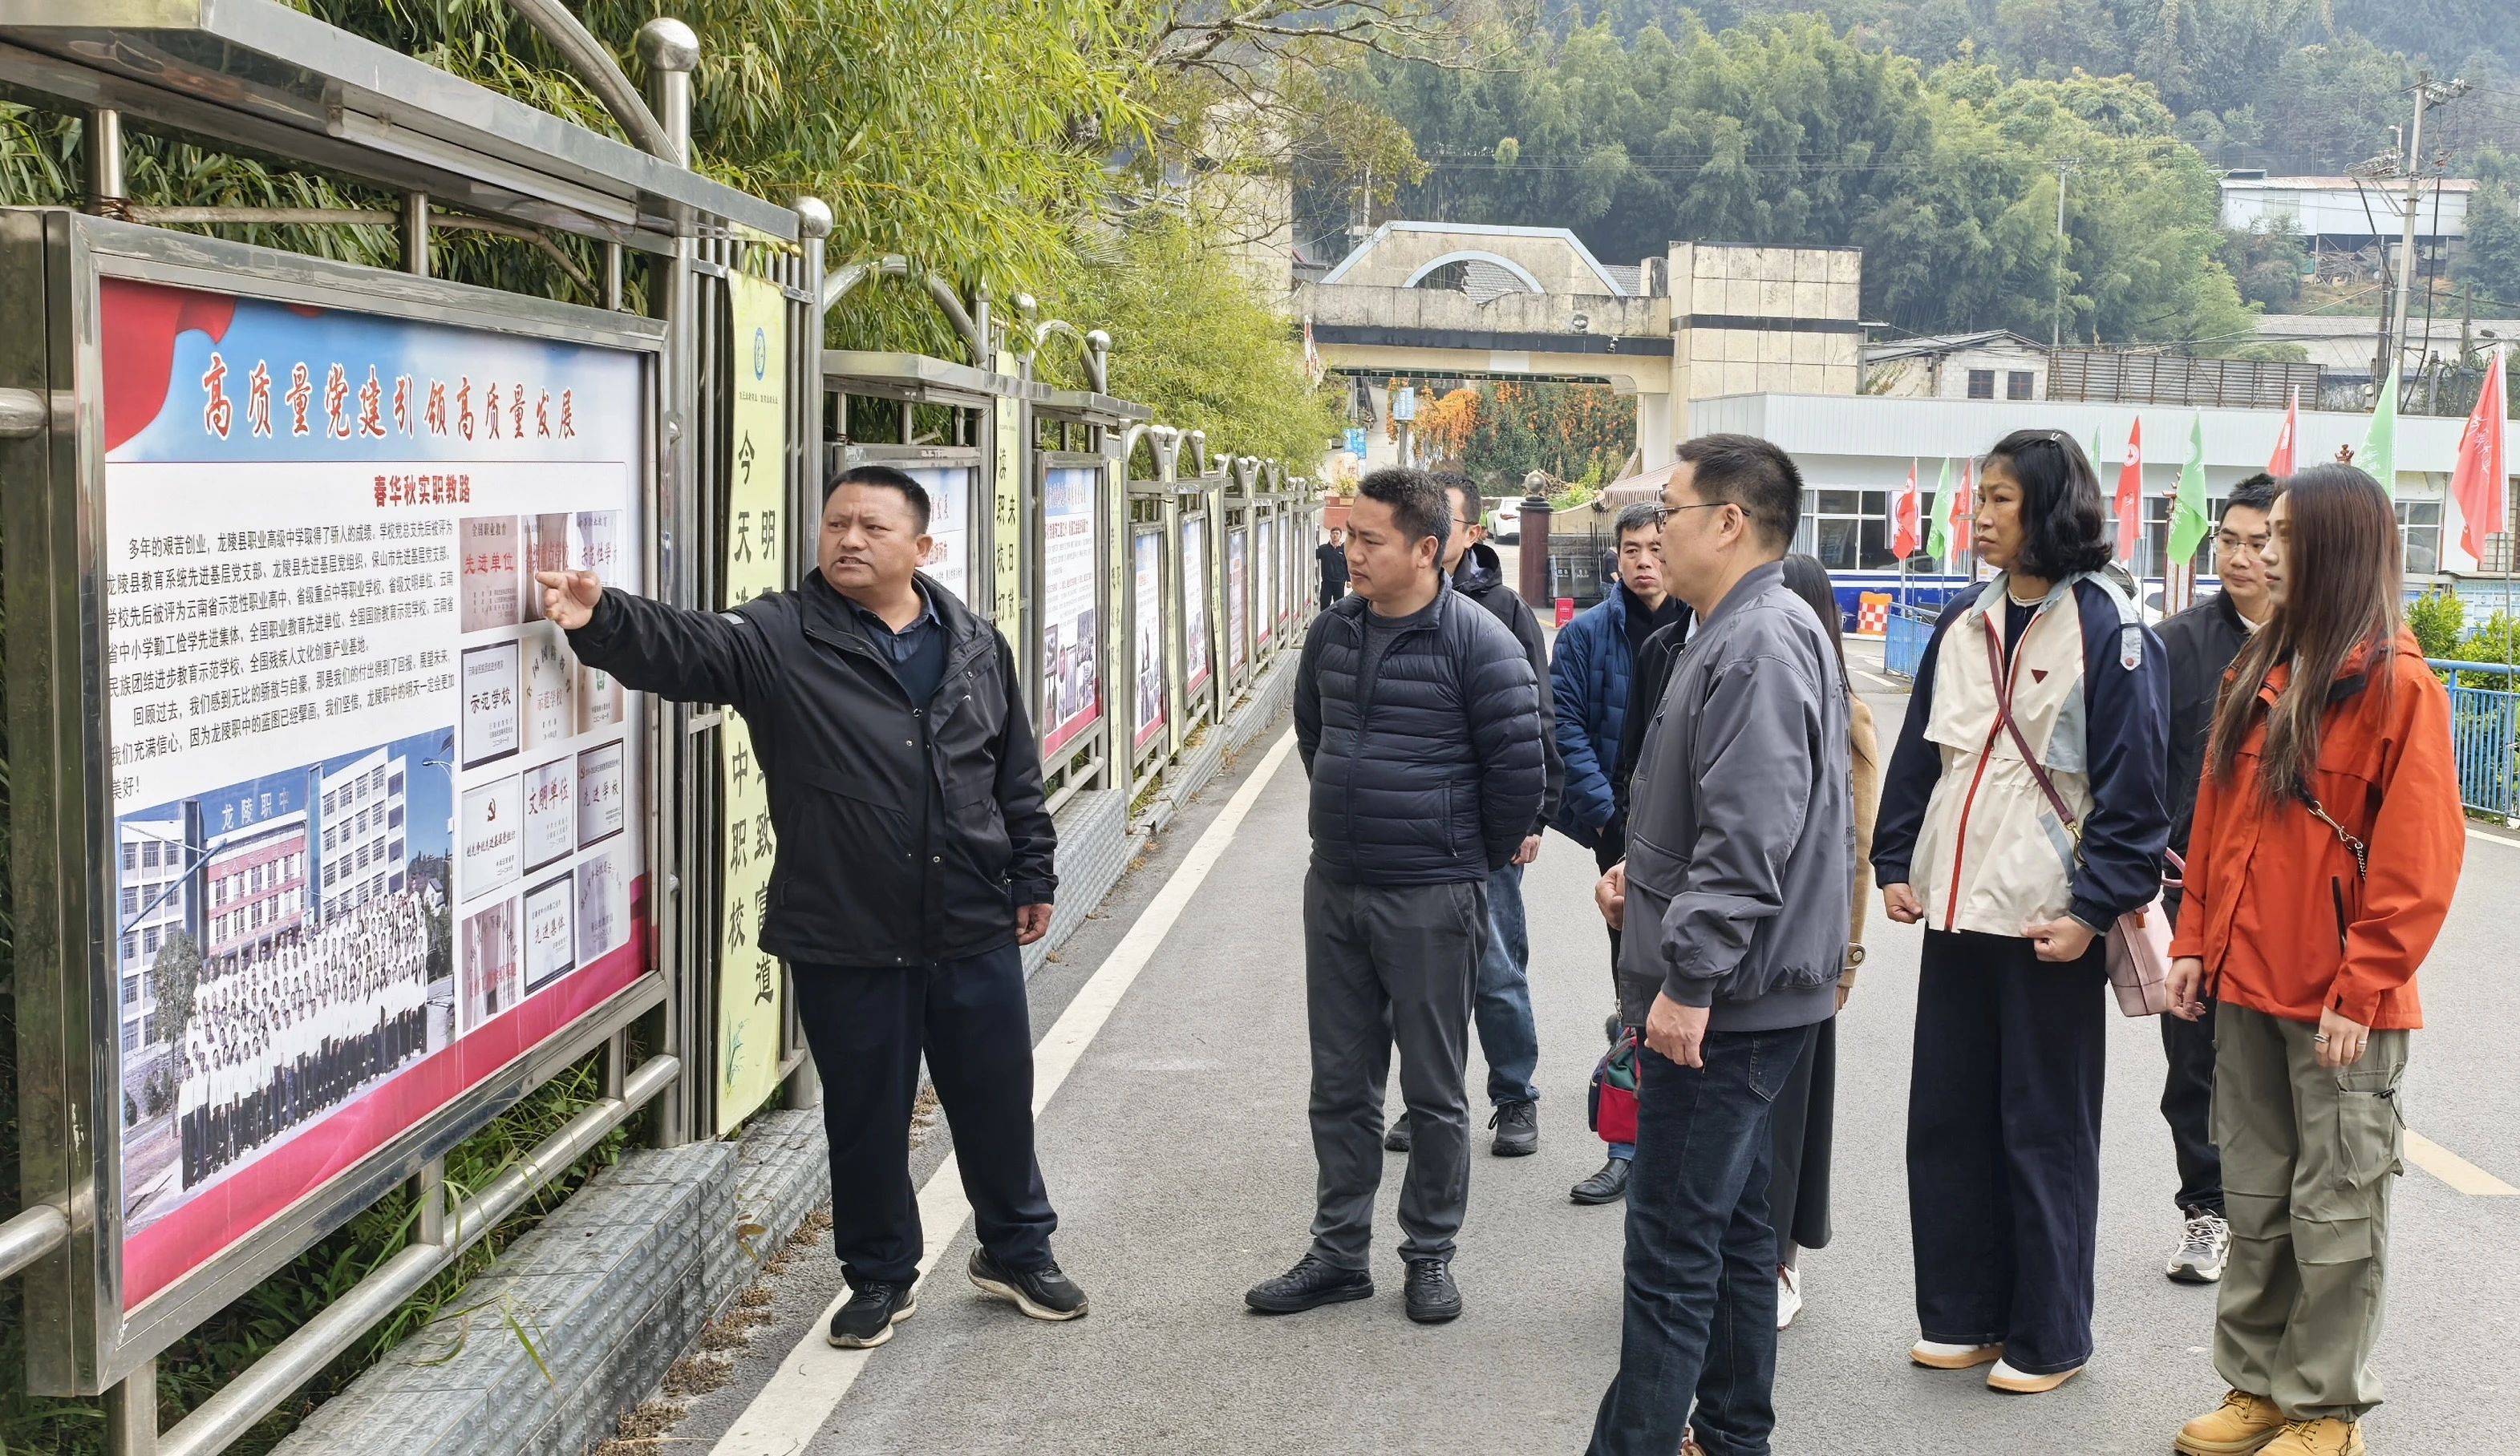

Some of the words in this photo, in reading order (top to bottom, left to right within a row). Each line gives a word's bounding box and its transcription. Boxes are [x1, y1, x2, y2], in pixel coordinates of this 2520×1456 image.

[202, 350, 577, 442] 高质量党建引领高质量发展
[374, 474, 472, 507] 春华秋实职教路
[464, 552, 514, 575] 先进单位
[470, 686, 512, 714] 示范学校
[221, 787, 290, 831] 龙陵职中
[529, 776, 569, 815] 文明单位
